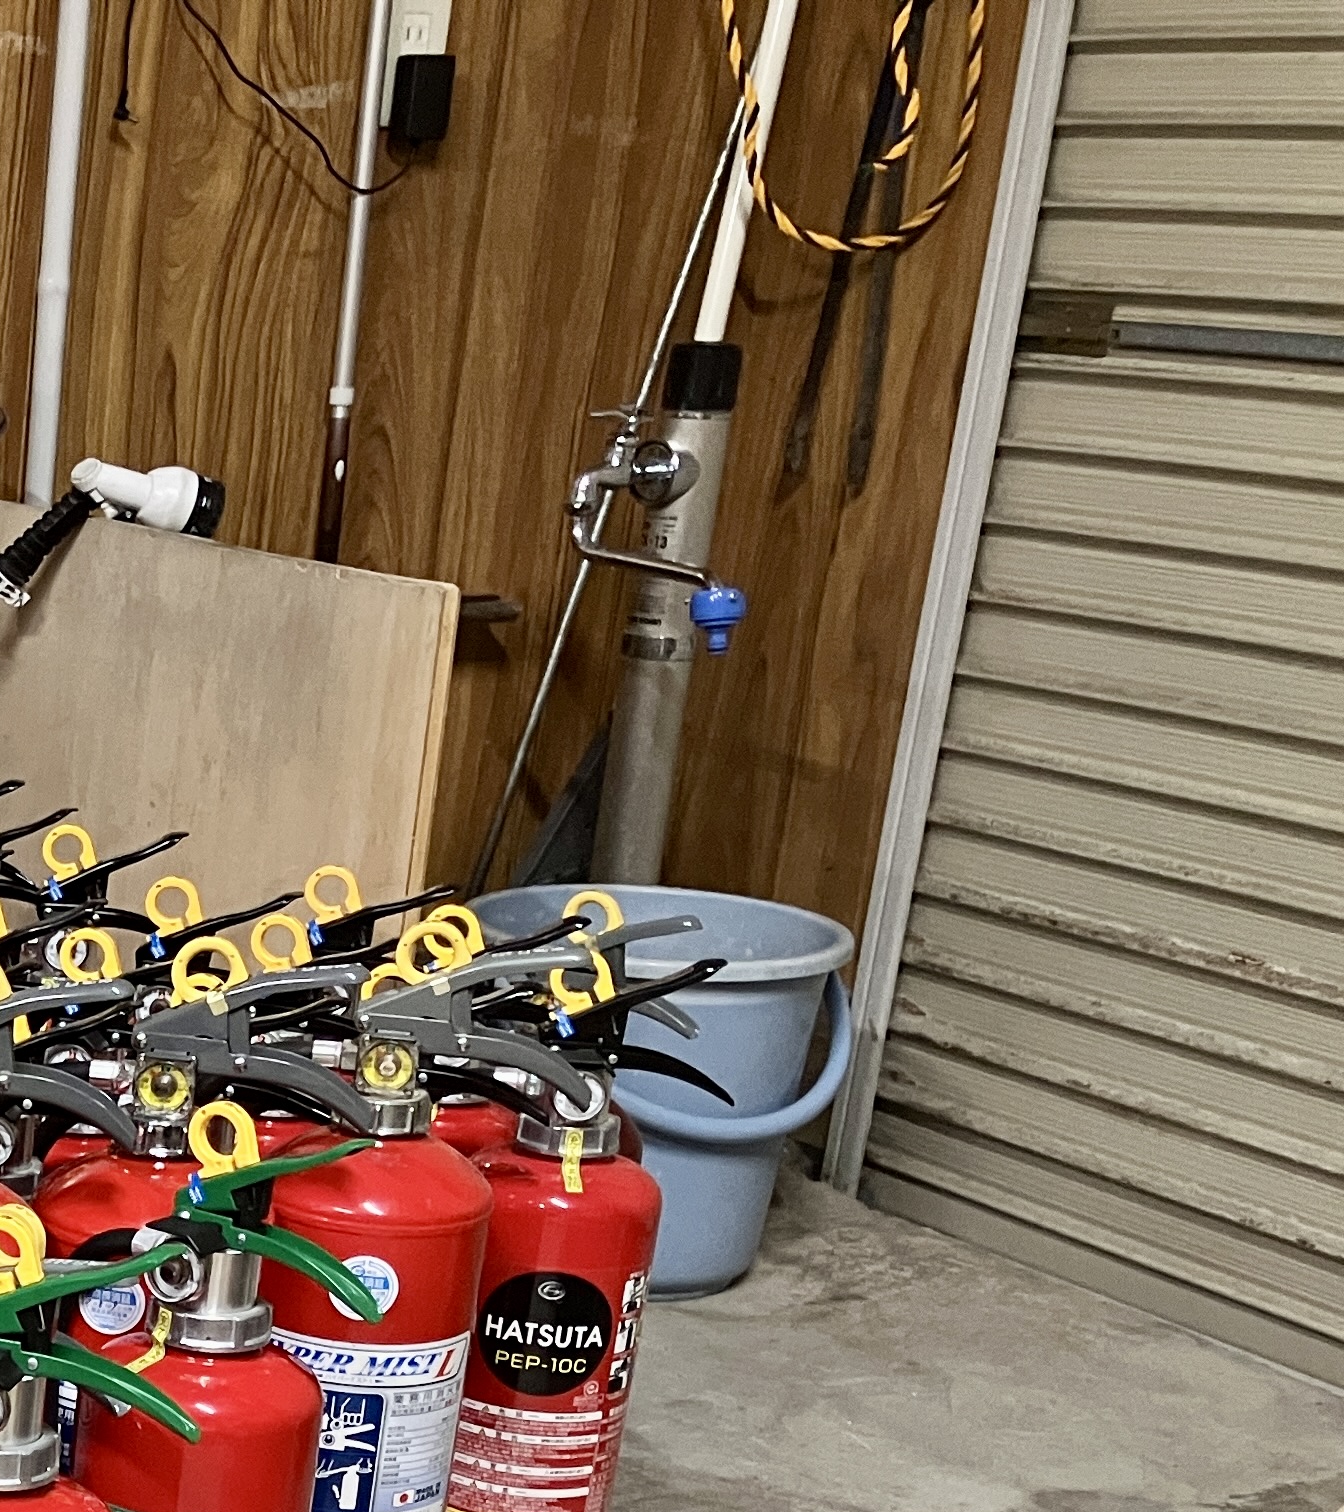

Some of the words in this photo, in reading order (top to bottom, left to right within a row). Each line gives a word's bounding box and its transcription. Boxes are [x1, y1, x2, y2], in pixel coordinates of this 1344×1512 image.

[484, 1313, 604, 1349] HATSUTA
[362, 1351, 443, 1377] MIST
[433, 1347, 458, 1379] L
[494, 1349, 588, 1374] PEP-10C
